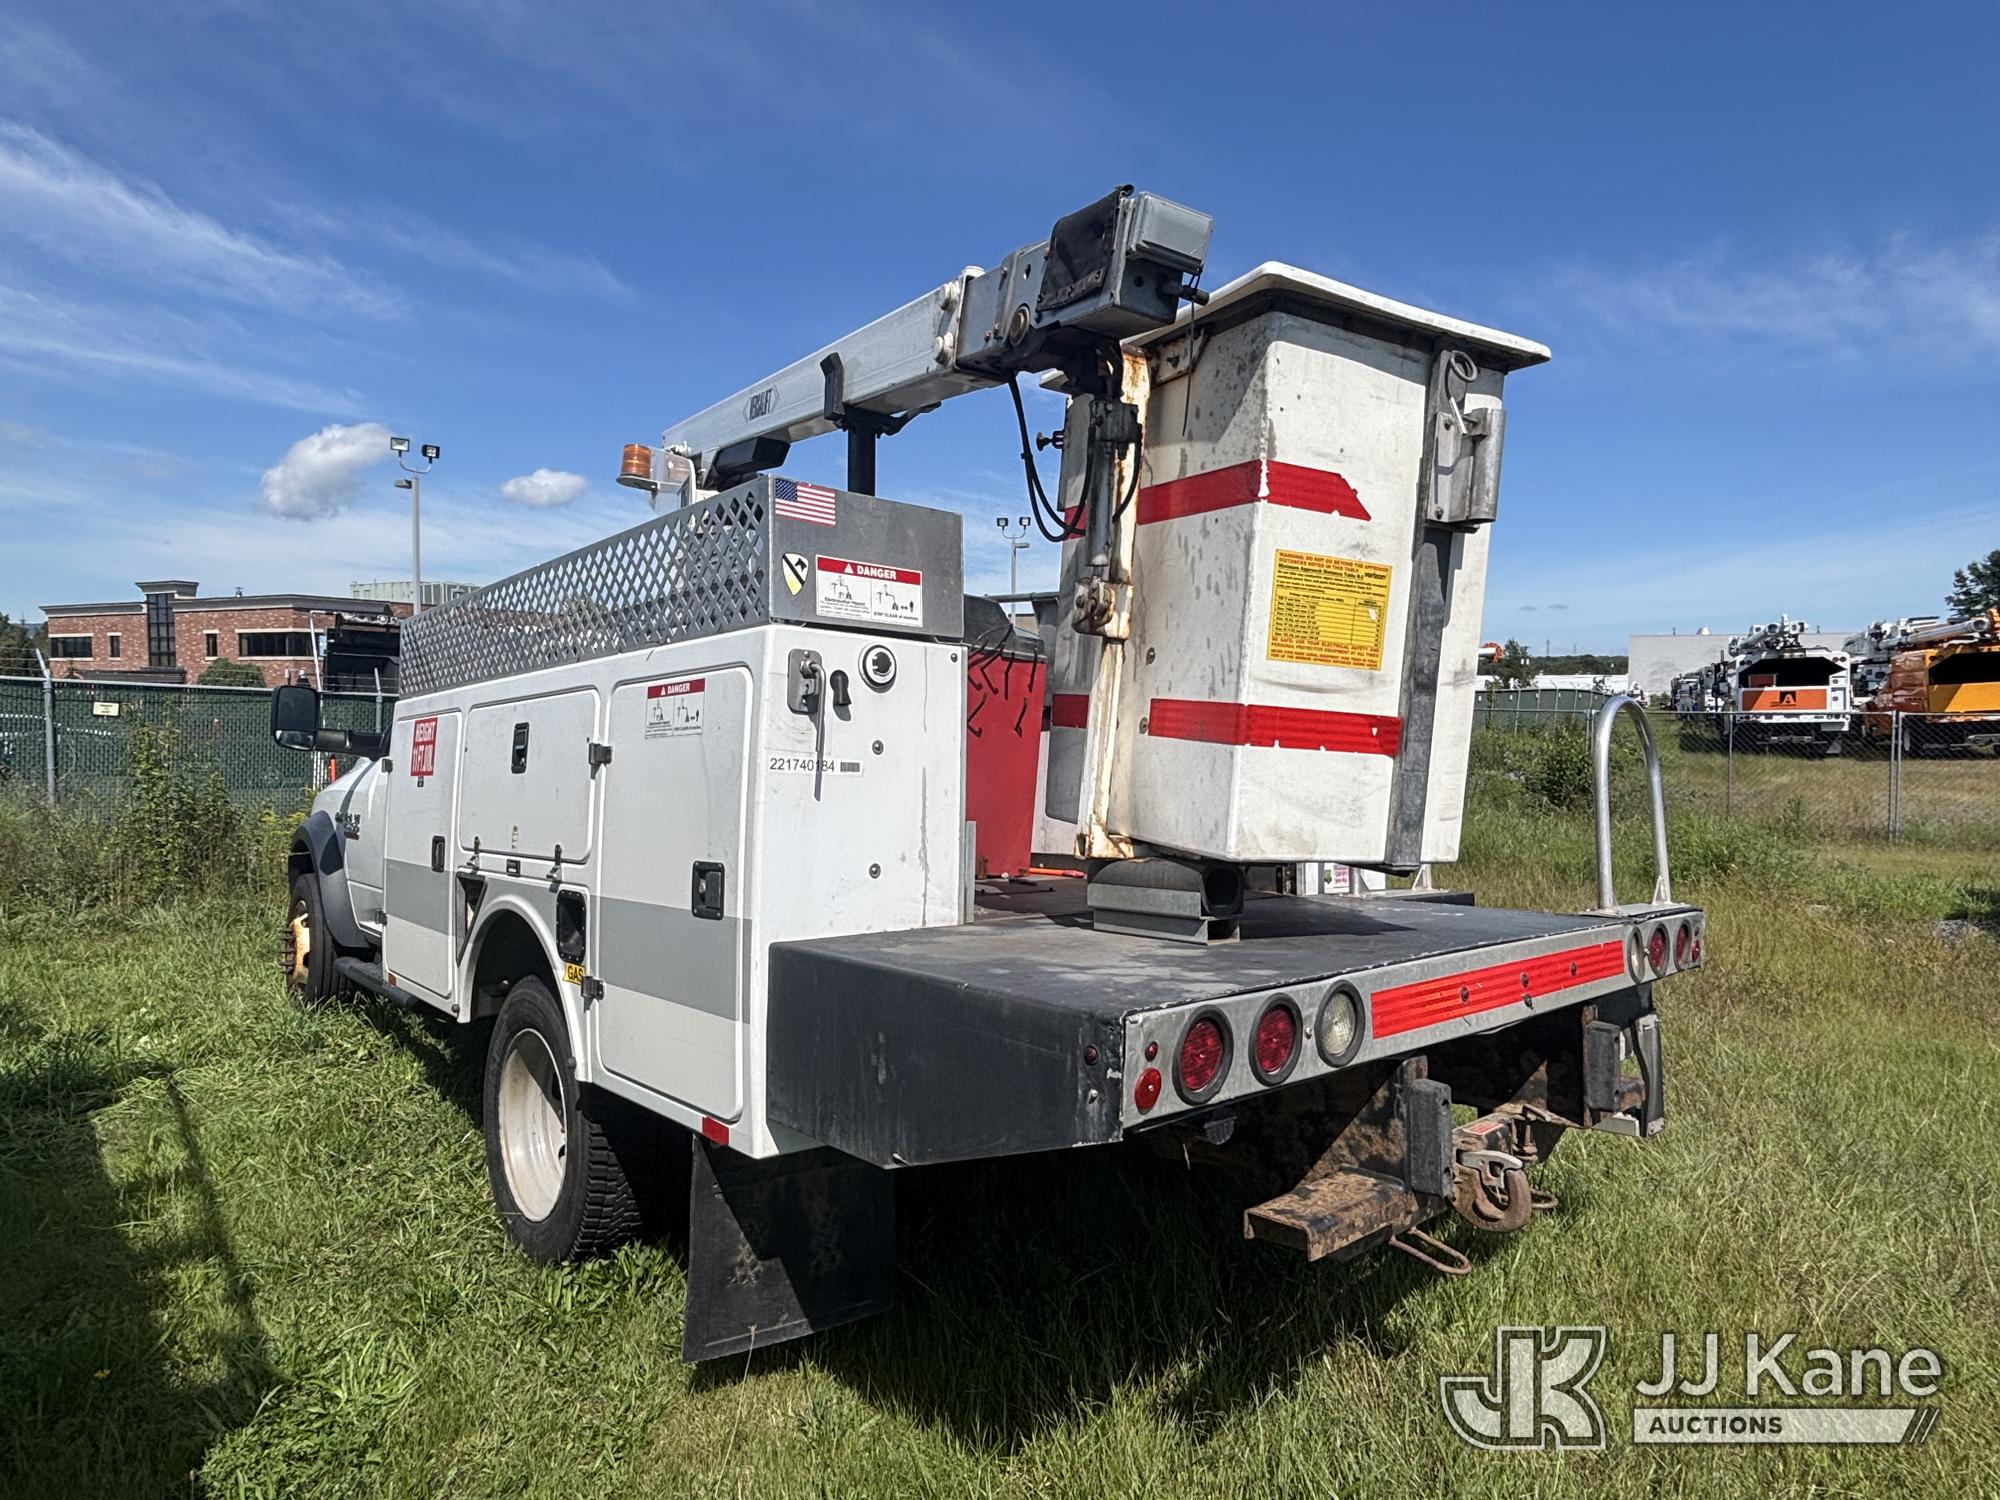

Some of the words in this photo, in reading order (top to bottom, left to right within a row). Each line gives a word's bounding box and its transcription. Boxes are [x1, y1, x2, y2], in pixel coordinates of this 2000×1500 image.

[857, 565, 896, 580] DANGER
[667, 682, 690, 695] DANGER
[415, 721, 436, 742] HEIGHT
[769, 757, 835, 772] 221740184
[567, 965, 584, 981] GAS
